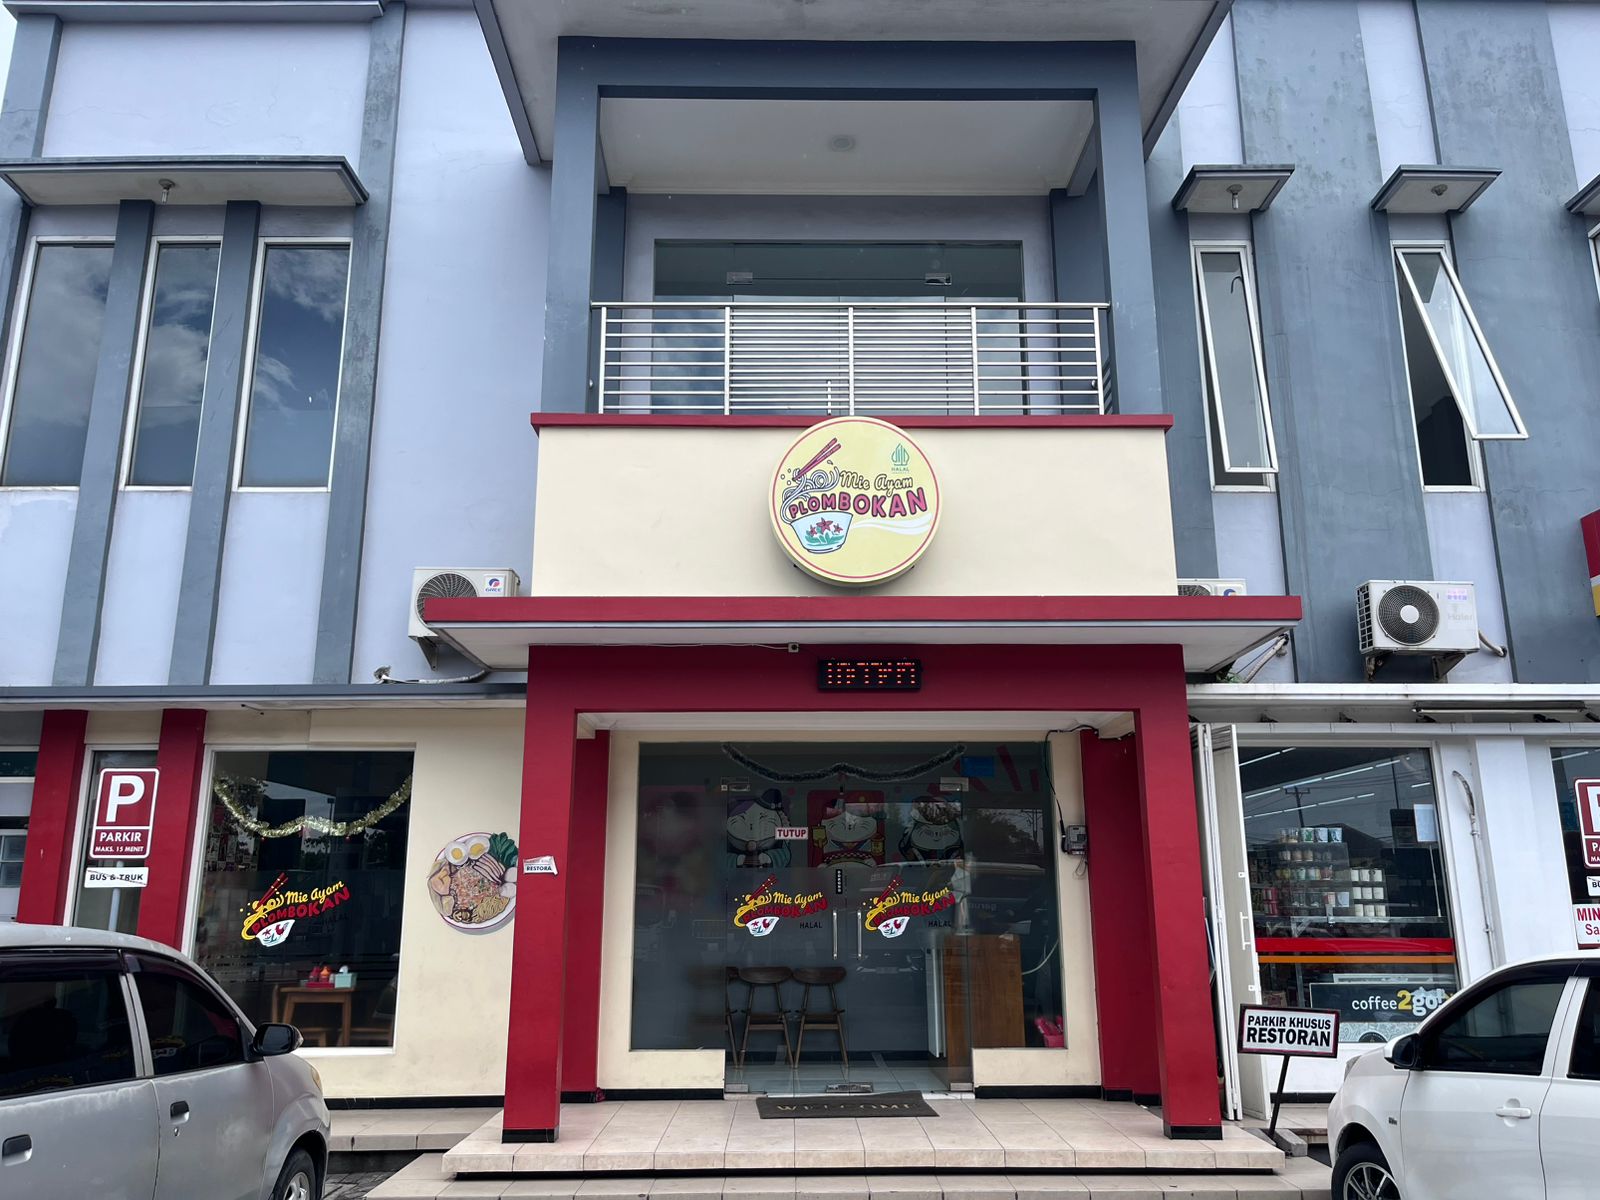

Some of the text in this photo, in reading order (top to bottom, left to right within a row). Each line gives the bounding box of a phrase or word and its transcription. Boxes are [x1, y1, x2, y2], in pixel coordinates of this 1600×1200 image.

[840, 470, 913, 496] Mie Ayam
[788, 487, 928, 519] PLOMBOKAN
[105, 775, 145, 822] P
[99, 832, 142, 842] PARKIR
[777, 829, 807, 838] TUTUP
[285, 880, 345, 905] Mie Ayam
[773, 891, 824, 908] Mie Ayam
[900, 886, 950, 906] Mie Ayam
[251, 886, 351, 934] PLOMBOKAN
[742, 897, 828, 924] PLOMBOKAN
[873, 892, 956, 926] PLOMBOKAN
[1248, 1015, 1331, 1030] PARKIR KHUSUS
[1246, 1027, 1331, 1047] RESTORAN
